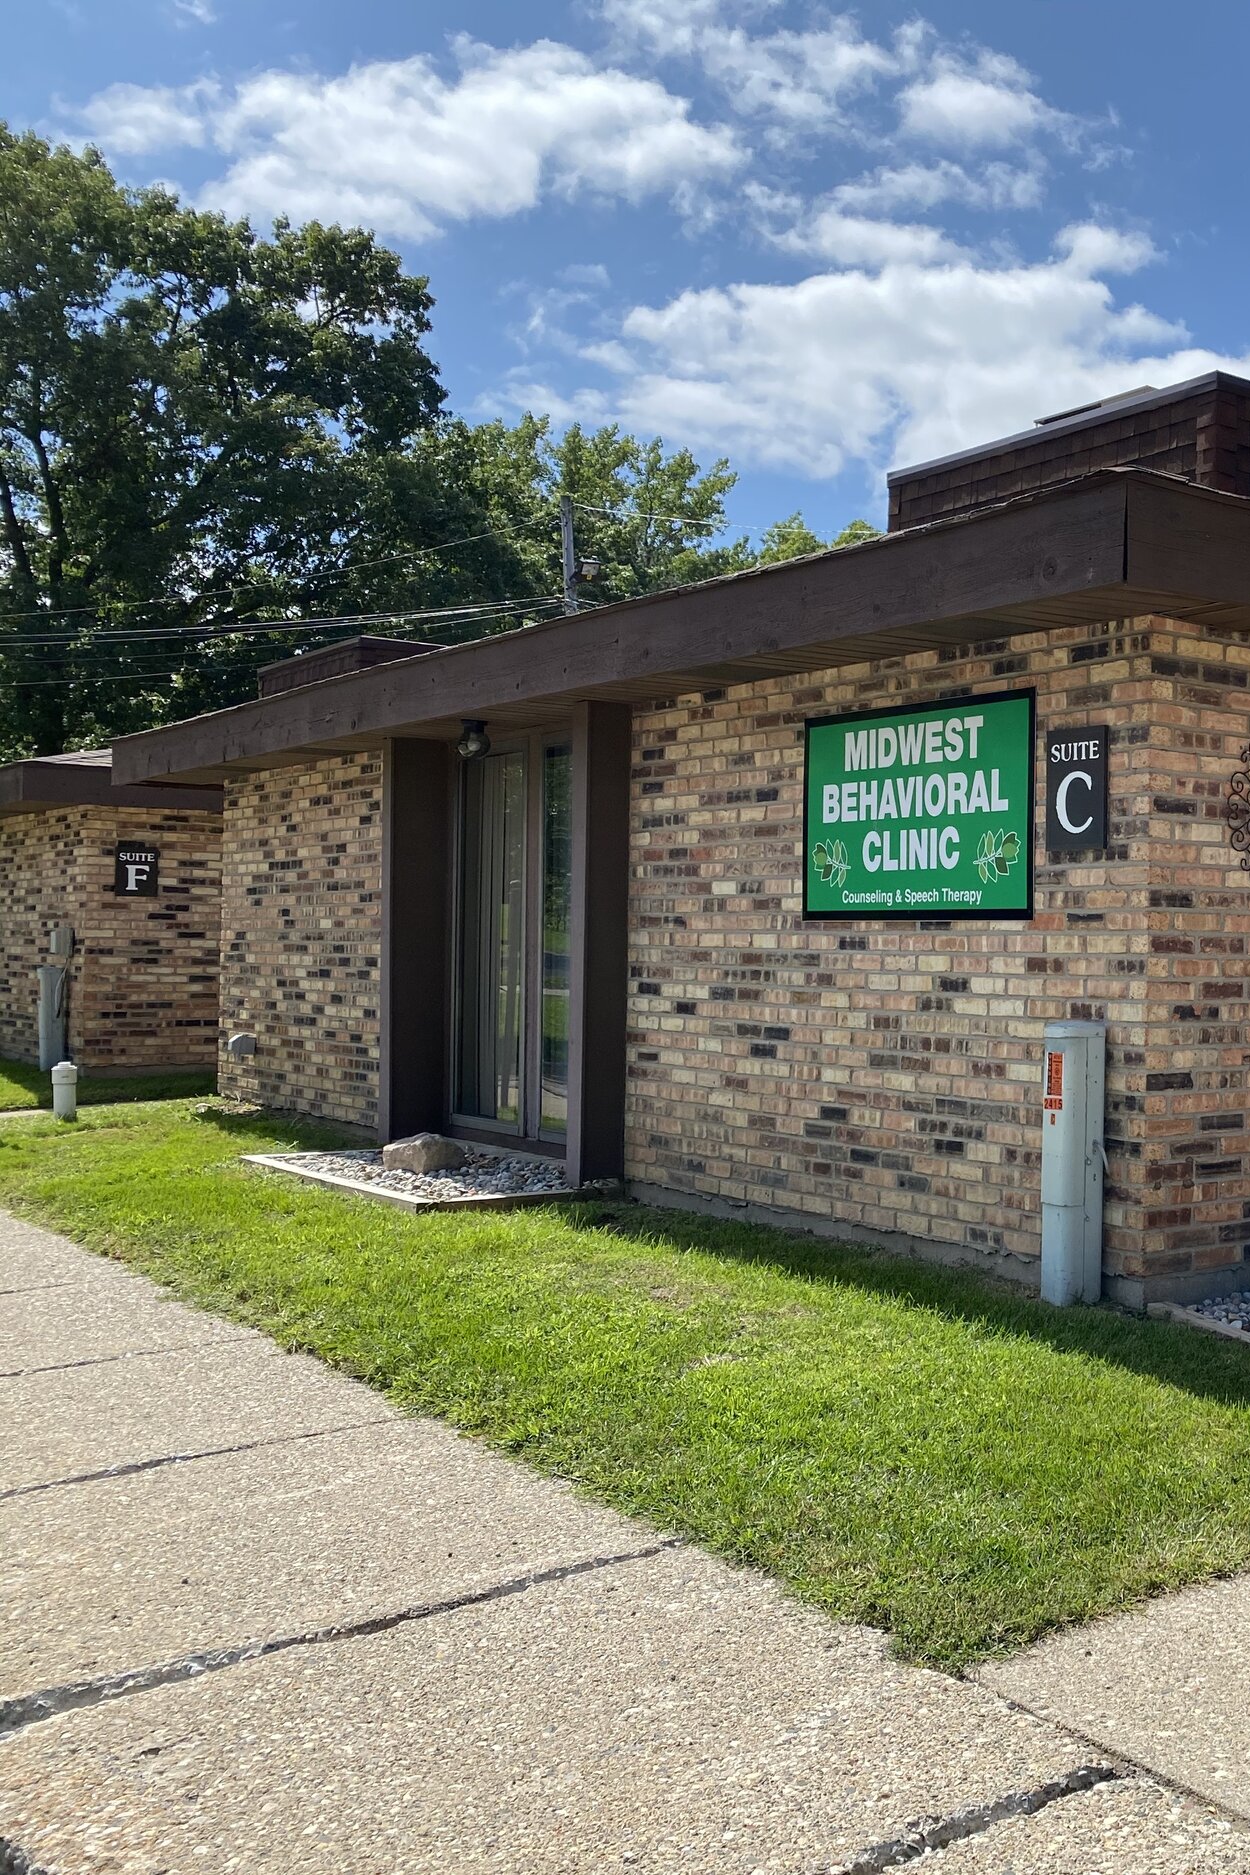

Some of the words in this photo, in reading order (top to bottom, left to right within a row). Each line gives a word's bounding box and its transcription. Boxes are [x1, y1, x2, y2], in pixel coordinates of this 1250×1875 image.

[844, 715, 984, 772] MIDWEST
[1050, 740, 1100, 763] SUITE
[822, 768, 1009, 824] BEHAVIORAL
[1055, 770, 1094, 834] C
[118, 852, 155, 862] SUITE
[862, 826, 960, 873] CLINIC
[125, 864, 150, 891] F
[842, 889, 893, 907] Counseling
[895, 889, 902, 903] &
[904, 888, 939, 906] Speech
[941, 887, 982, 905] Therapy
[1044, 1098, 1062, 1110] 2415
